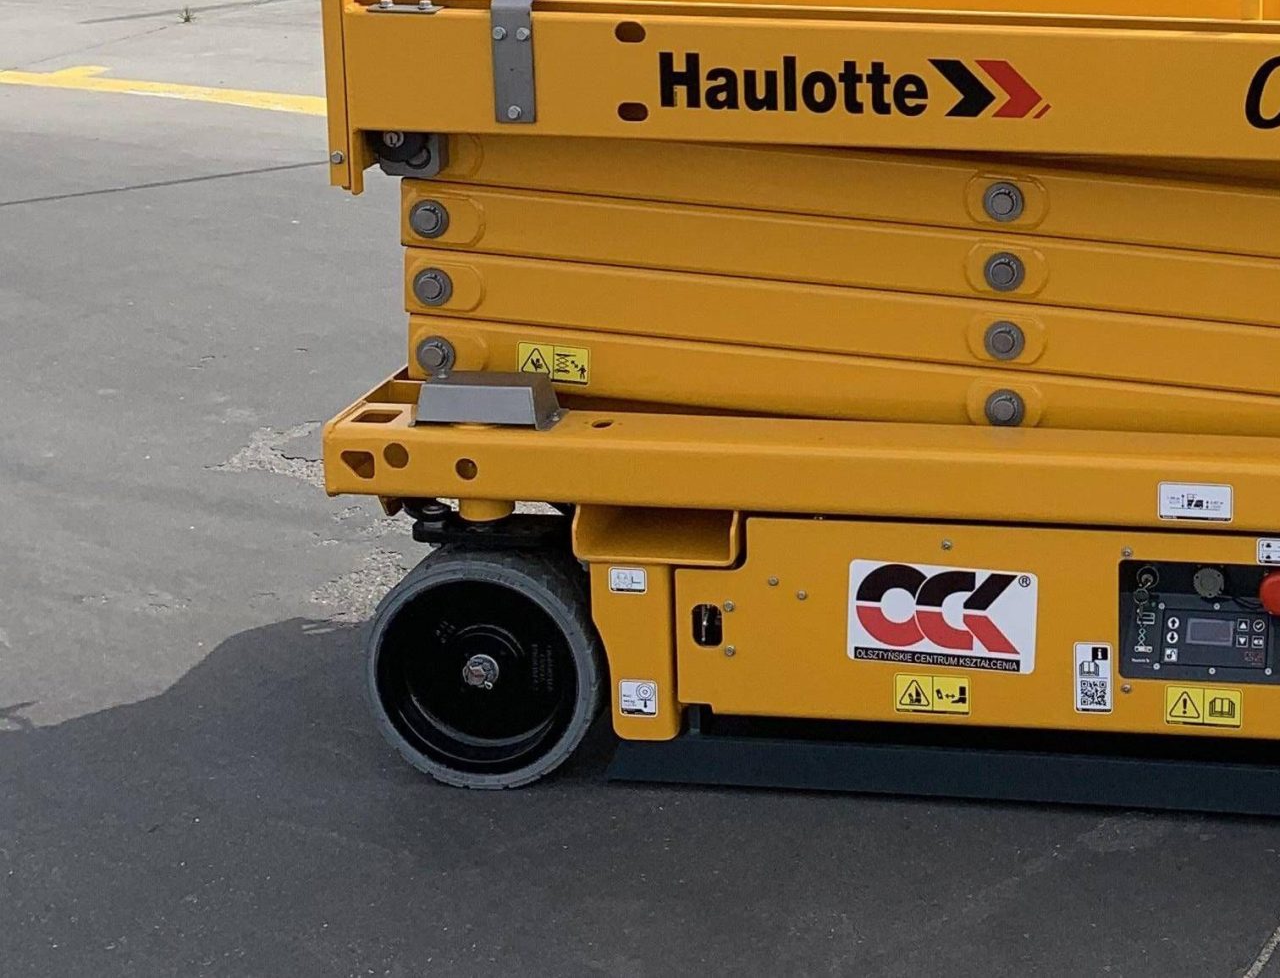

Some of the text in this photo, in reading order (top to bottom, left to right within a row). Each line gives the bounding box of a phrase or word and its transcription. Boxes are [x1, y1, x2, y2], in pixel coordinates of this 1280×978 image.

[659, 52, 928, 116] Haulotte
[856, 563, 1020, 654] OCK
[856, 649, 1018, 670] OLSZTYŃSKIE CENTRUM KSZTAŁCENIA
